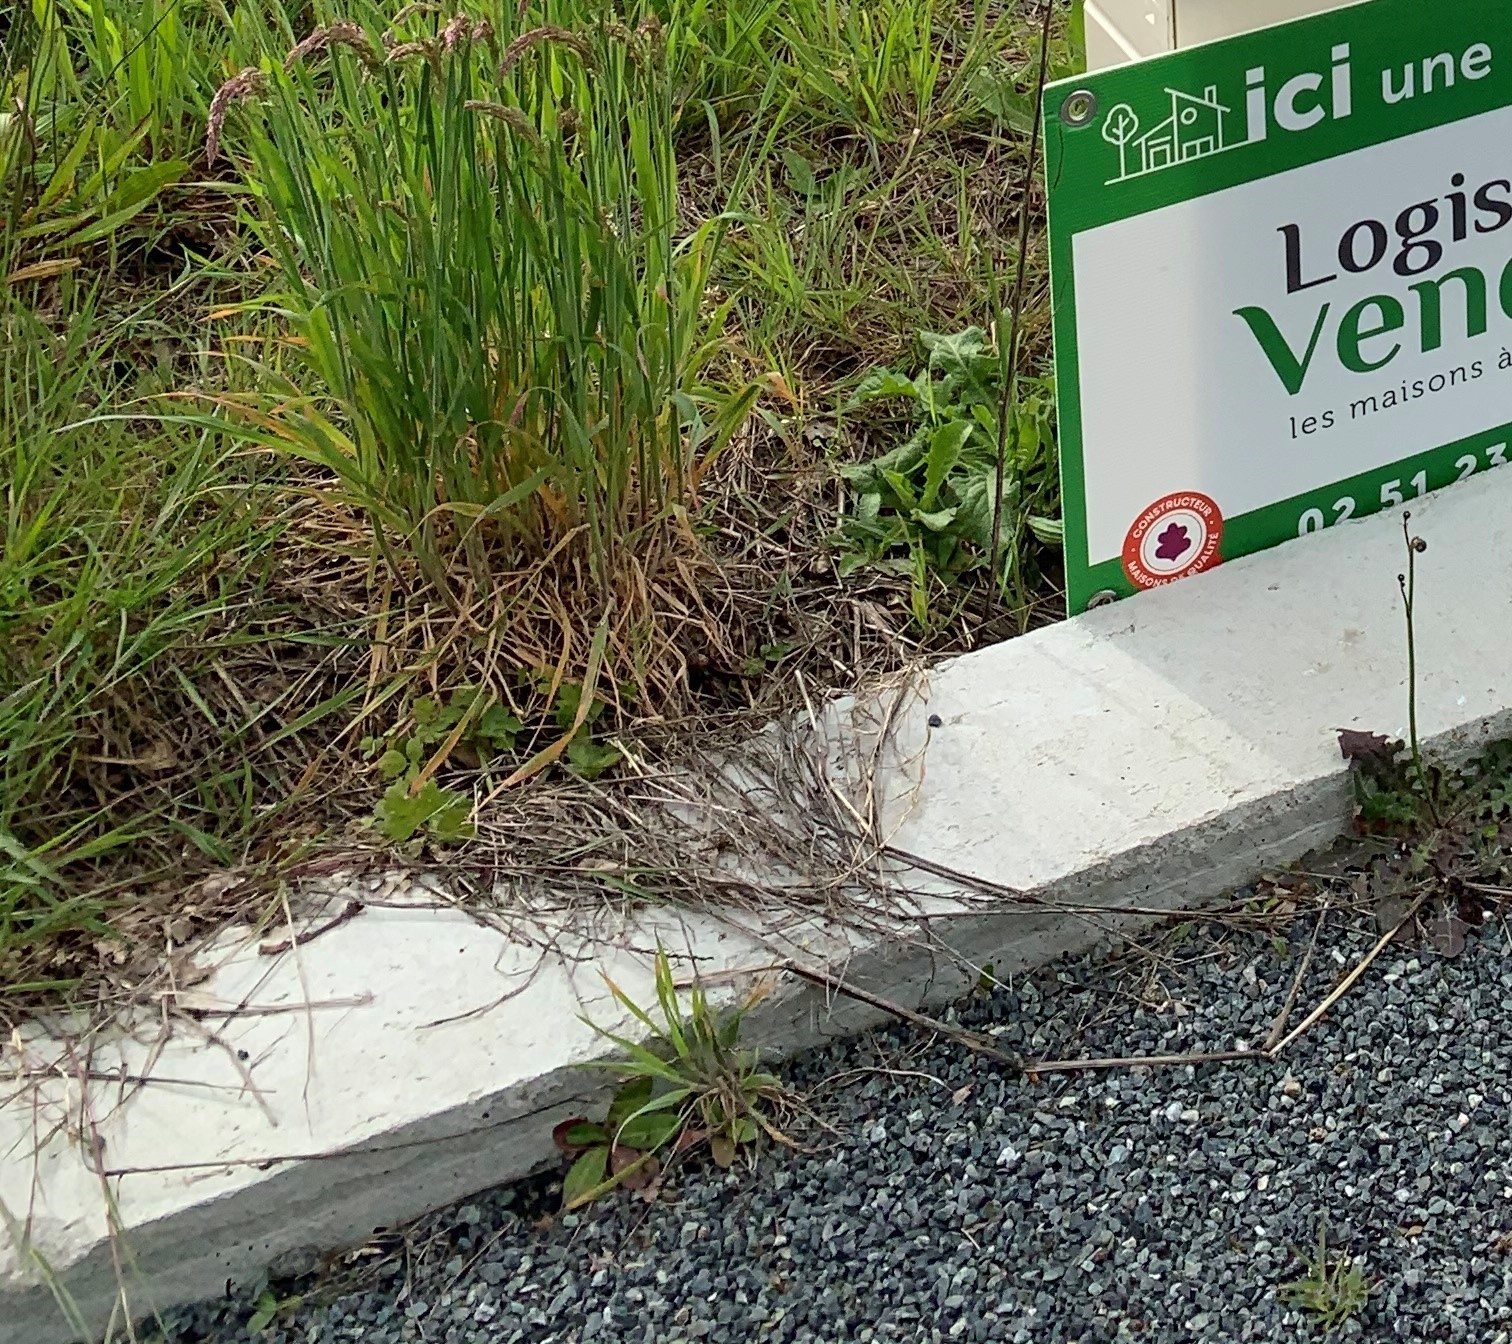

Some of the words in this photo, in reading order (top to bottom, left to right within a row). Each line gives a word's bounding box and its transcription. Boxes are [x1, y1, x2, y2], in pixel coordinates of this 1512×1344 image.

[1245, 42, 1352, 142] ici
[1381, 42, 1492, 104] une
[1289, 407, 1335, 440] les
[1349, 359, 1484, 420] maisons
[1497, 347, 1512, 371] à
[1132, 496, 1213, 539] CONSTRUCTEUR
[1298, 496, 1357, 536] 02
[1379, 470, 1427, 509] 51
